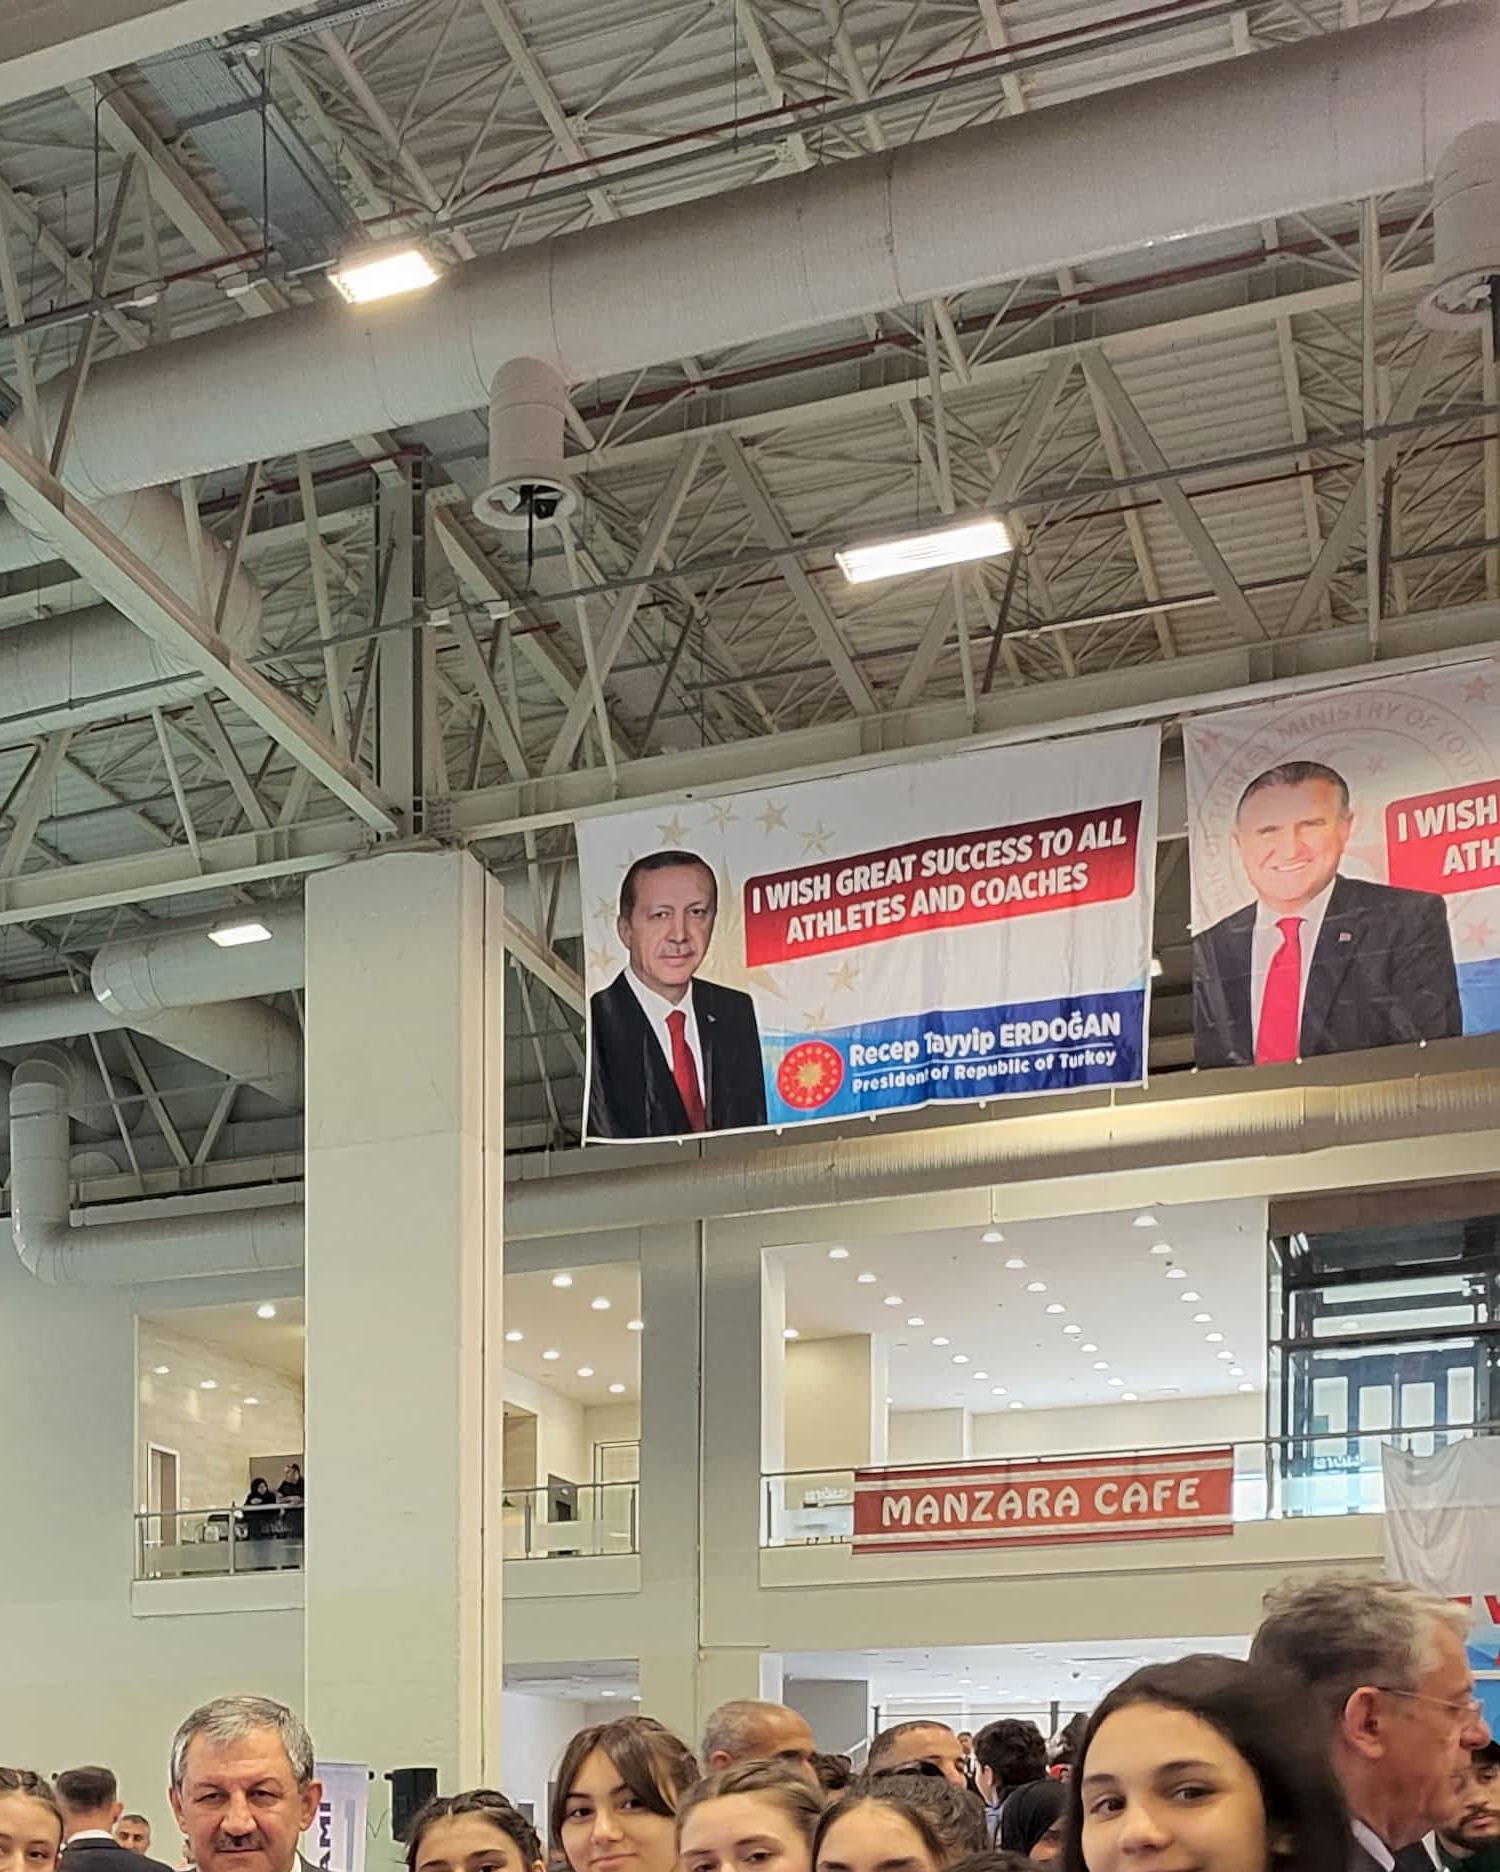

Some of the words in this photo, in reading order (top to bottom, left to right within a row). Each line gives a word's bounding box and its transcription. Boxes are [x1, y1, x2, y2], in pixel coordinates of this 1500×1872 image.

[1396, 812, 1407, 843] I
[1414, 794, 1497, 838] WISH
[752, 887, 761, 913] I
[765, 873, 831, 911] WISH
[835, 854, 917, 897] GREAT
[921, 835, 1032, 878] SUCCESS
[1038, 828, 1073, 858] TO
[1077, 817, 1127, 852] ALL
[786, 894, 906, 944] ATHLETES
[911, 883, 965, 917] AND
[971, 863, 1088, 908] COACHES
[850, 1037, 919, 1067] Recep
[923, 1027, 995, 1058] Tayyip
[1000, 1010, 1121, 1048] ERDOĞAN
[930, 1065, 948, 1081] of
[954, 1059, 1030, 1081] Republic
[1035, 1052, 1053, 1069] of
[1059, 1050, 1117, 1069] Turkey
[882, 1485, 1080, 1527] MANZARA
[1094, 1477, 1200, 1515] CAFE
